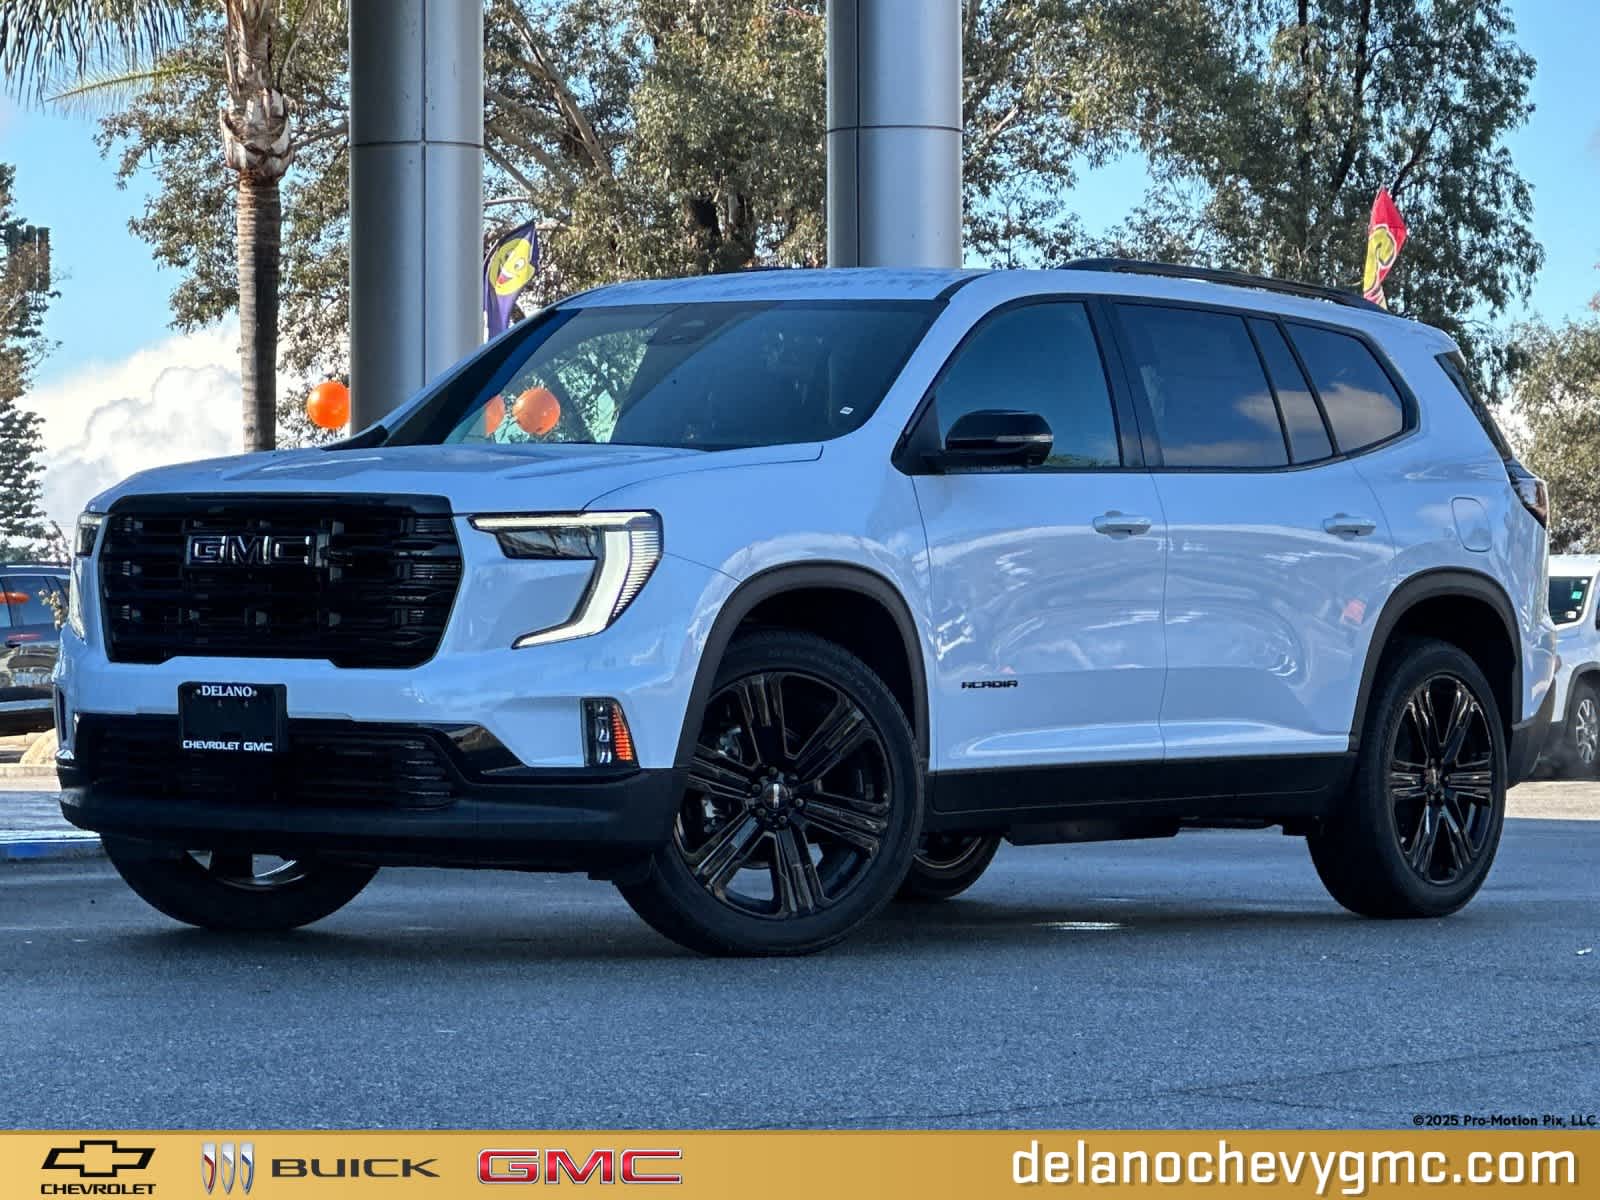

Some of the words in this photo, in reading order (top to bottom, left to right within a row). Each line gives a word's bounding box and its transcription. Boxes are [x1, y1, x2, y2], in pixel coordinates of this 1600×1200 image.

[186, 535, 312, 565] GMC
[961, 680, 1018, 689] ACADIA
[201, 685, 252, 697] DELANO
[182, 740, 240, 751] CHEVROLET
[243, 741, 273, 752] GMC
